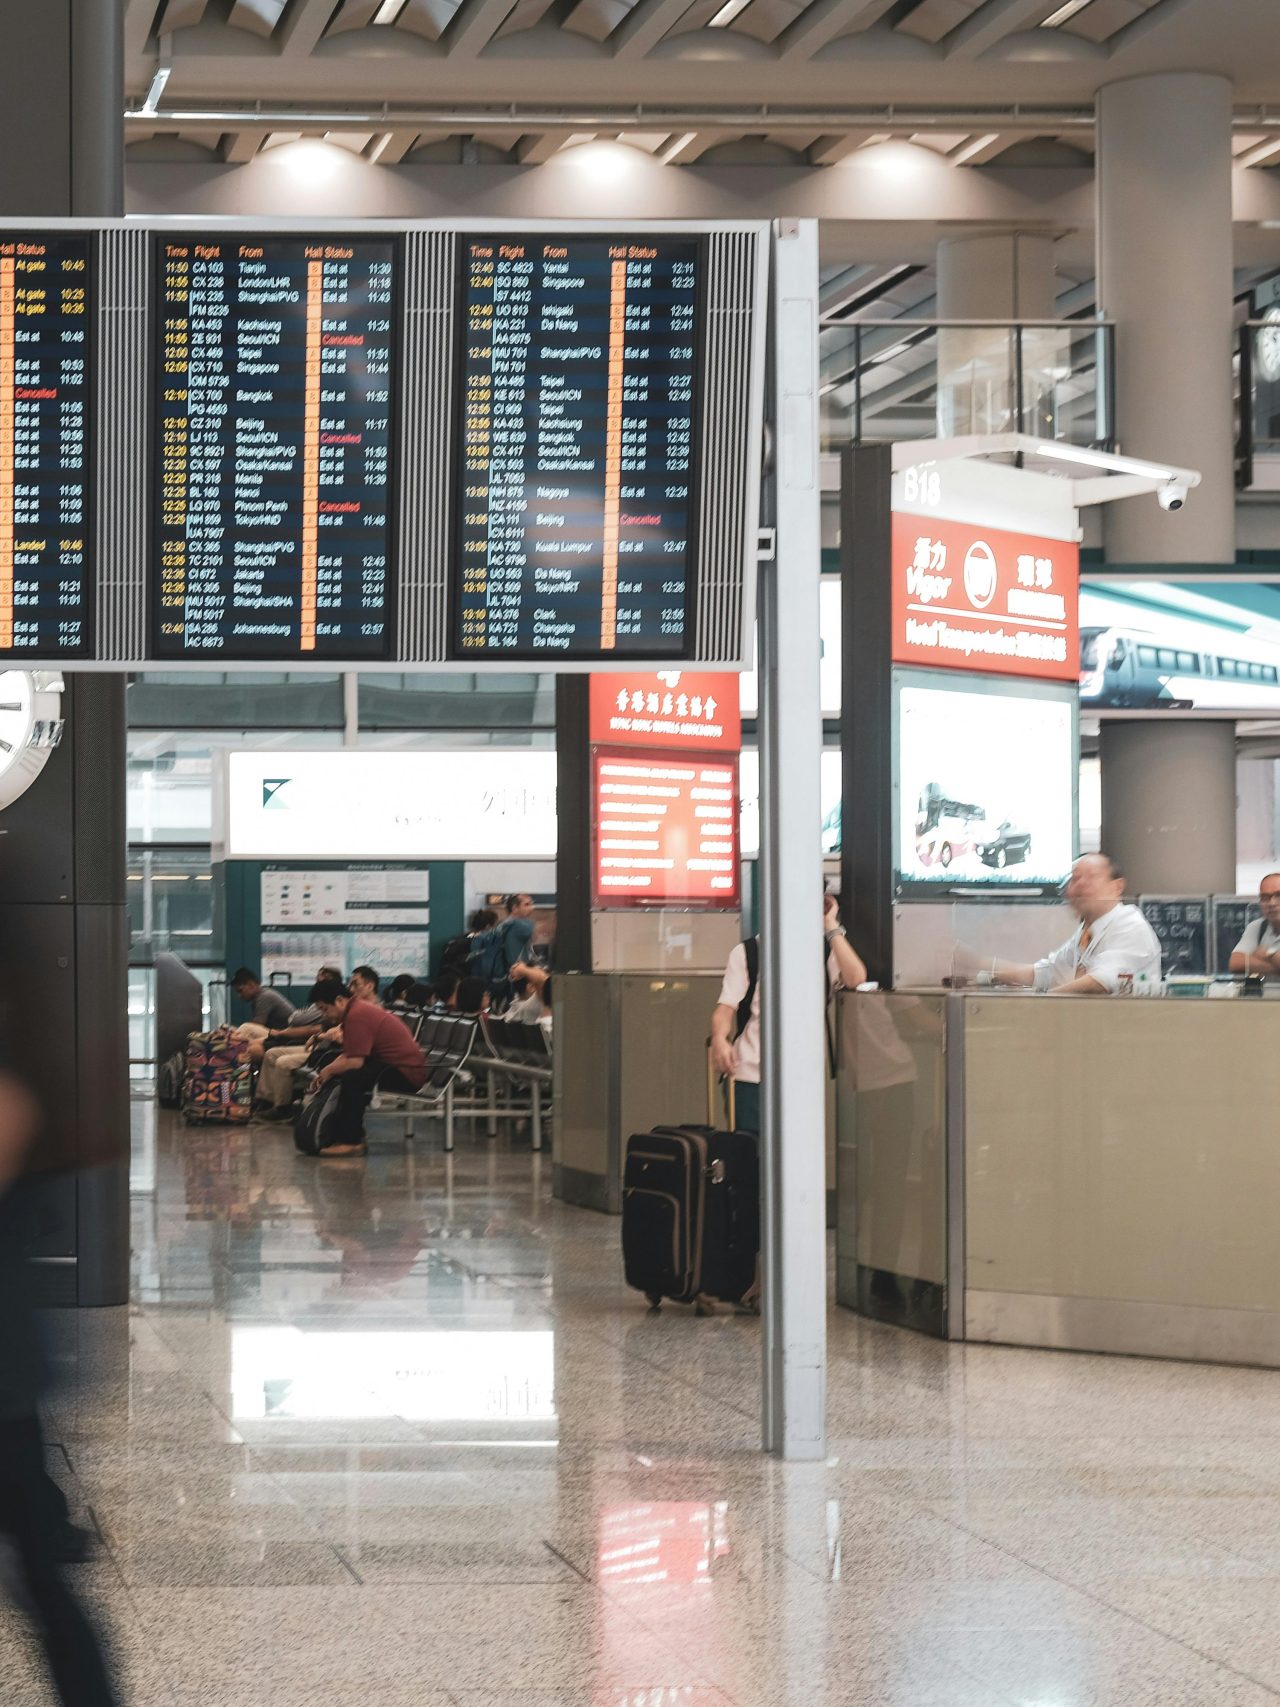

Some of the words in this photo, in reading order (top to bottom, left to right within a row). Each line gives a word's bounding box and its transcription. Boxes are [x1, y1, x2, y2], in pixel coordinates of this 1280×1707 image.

[16, 242, 45, 255] Status
[165, 245, 188, 257] Time
[194, 245, 220, 260] Flight
[238, 245, 263, 257] From
[304, 246, 323, 258] Hall
[324, 246, 353, 258] Status
[469, 245, 493, 257] Time
[498, 245, 524, 260] Flight
[543, 245, 567, 257] From
[608, 246, 627, 258] Hall
[627, 245, 657, 258] Status
[904, 466, 941, 507] B18
[905, 565, 954, 604] Vigor
